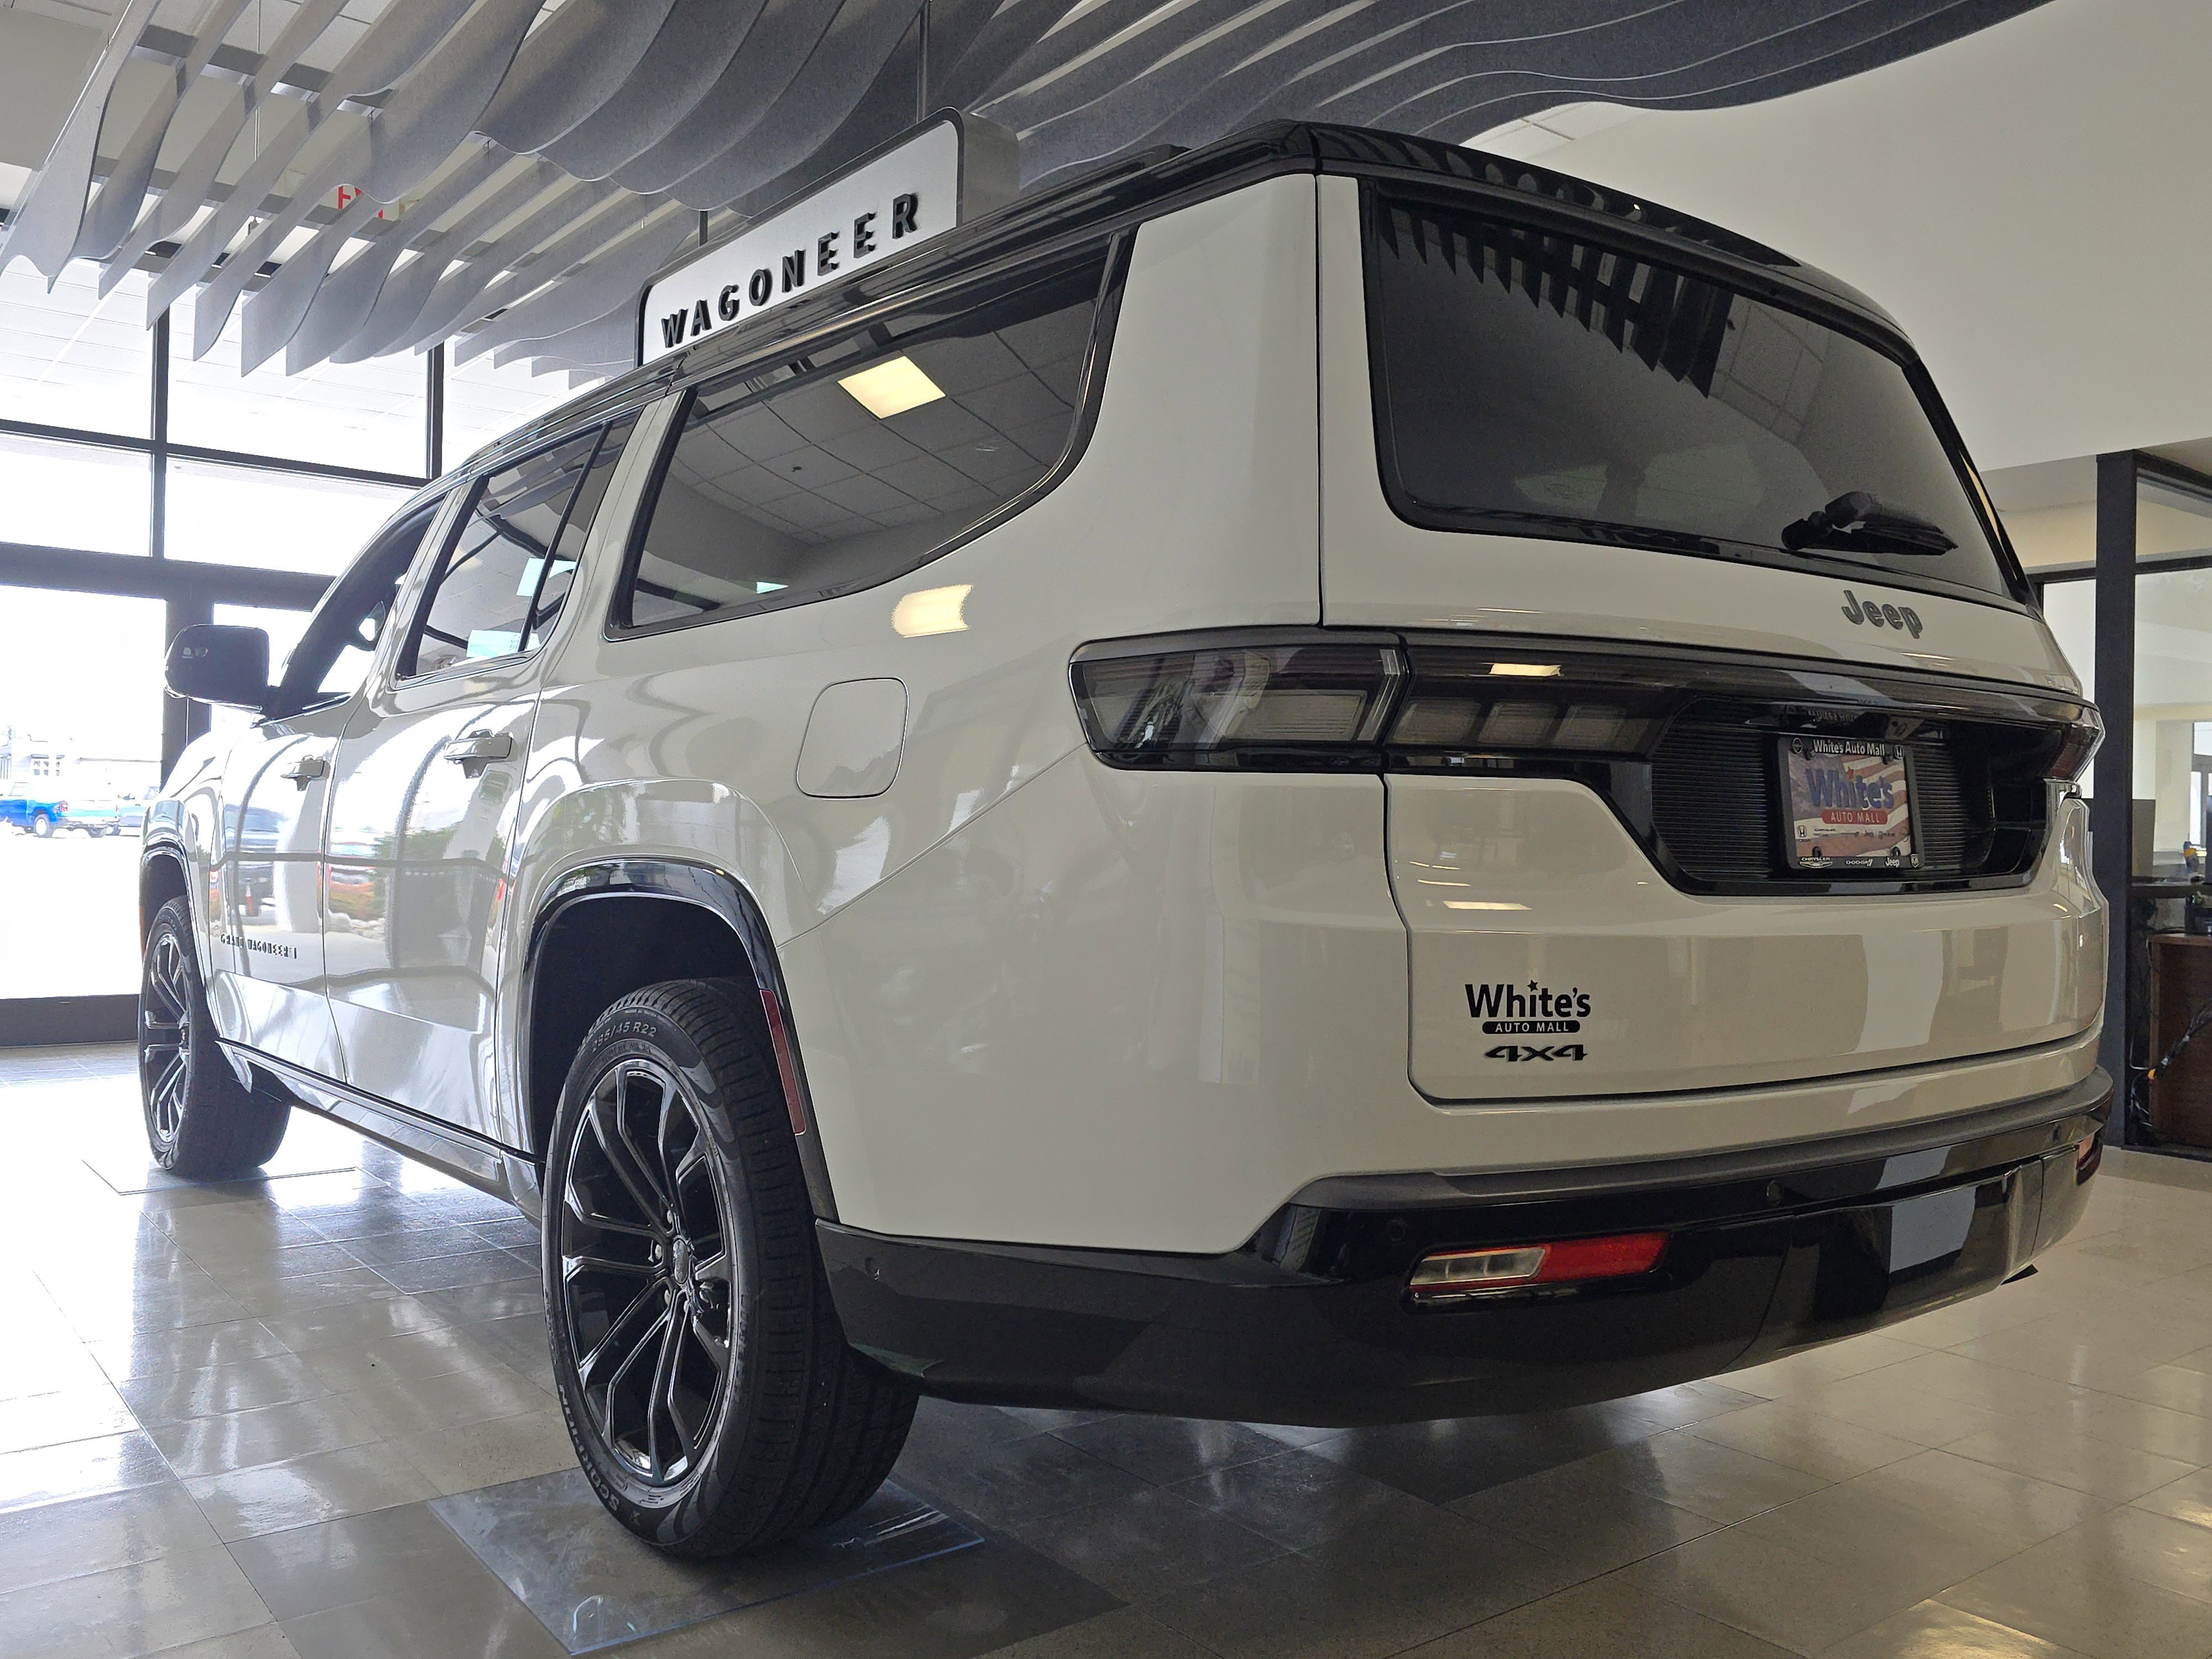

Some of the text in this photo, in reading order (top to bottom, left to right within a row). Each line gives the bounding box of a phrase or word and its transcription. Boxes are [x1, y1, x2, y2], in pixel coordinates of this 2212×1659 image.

[661, 193, 919, 348] WAGONEER
[1841, 589, 1923, 639] Jeep
[1813, 739, 1885, 756] White's Auto Mall
[1806, 766, 1895, 810] White's
[1830, 811, 1880, 823] AUTO MALL
[1885, 857, 1900, 868] Jeep
[247, 939, 289, 958] WAGONEER
[1464, 979, 1591, 1018] White's
[632, 1021, 657, 1038] R22
[1495, 1021, 1569, 1032] AUTO MALL
